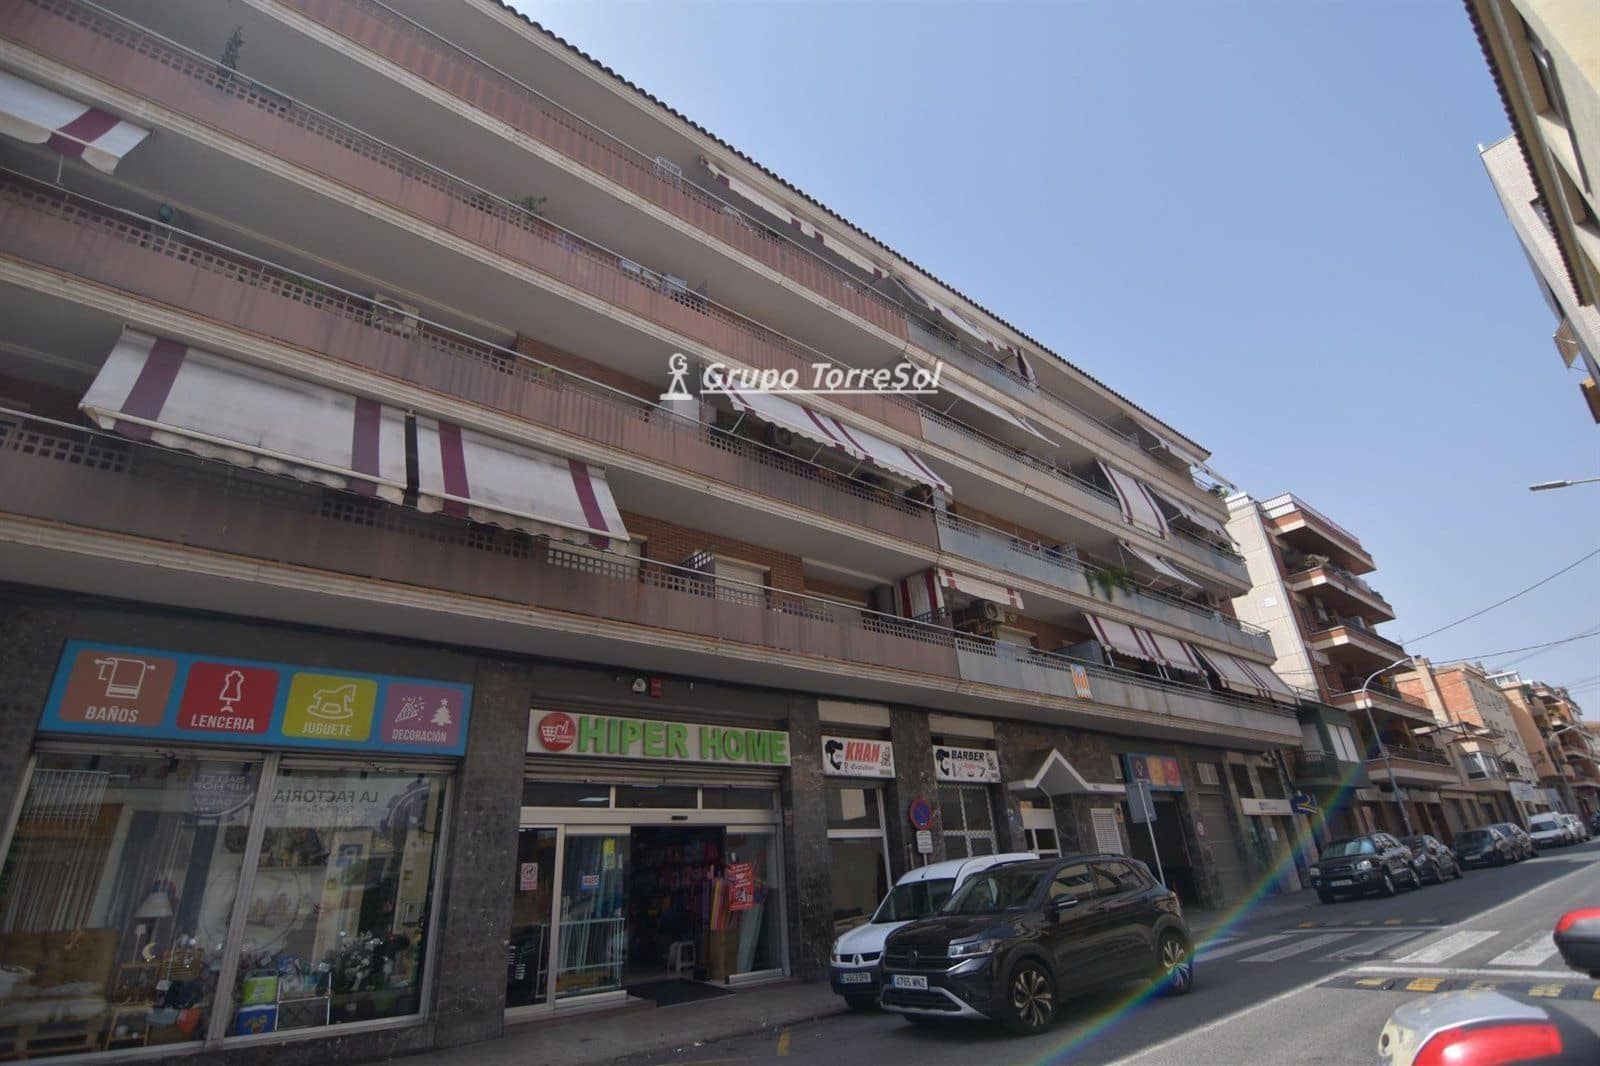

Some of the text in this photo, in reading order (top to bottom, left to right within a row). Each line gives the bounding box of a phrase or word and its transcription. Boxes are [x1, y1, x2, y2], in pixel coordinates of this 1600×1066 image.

[85, 704, 139, 723] BAÑOS
[191, 713, 255, 731] LENCERIA
[302, 720, 352, 737] JUGUETE
[578, 715, 789, 764] HIPER HOME
[845, 741, 881, 762] KHAN
[951, 749, 985, 761] BARBER
